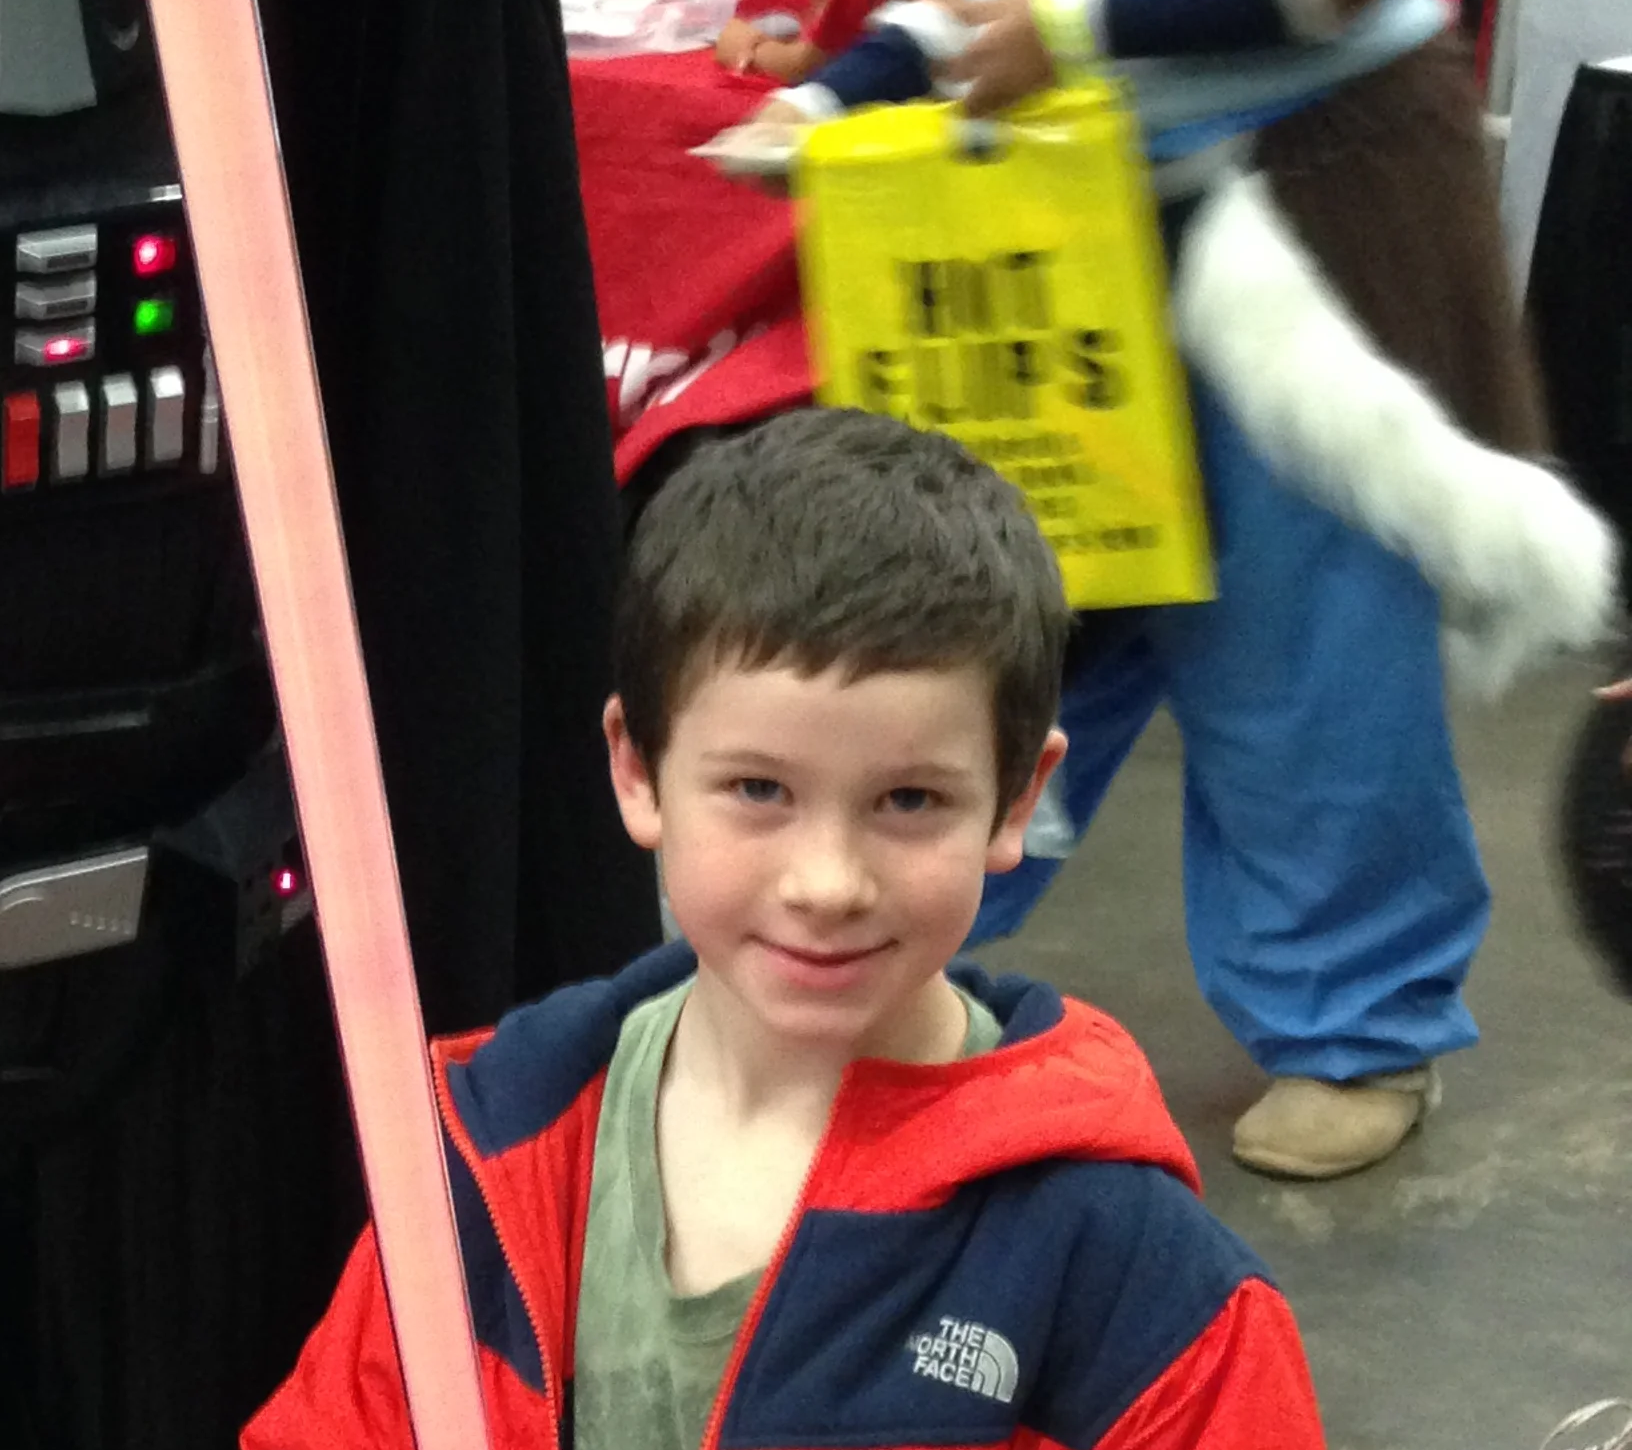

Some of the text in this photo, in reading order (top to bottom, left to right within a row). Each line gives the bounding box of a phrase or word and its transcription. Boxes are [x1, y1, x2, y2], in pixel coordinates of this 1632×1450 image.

[939, 1317, 986, 1348] THE
[906, 1333, 979, 1370] NORTH
[913, 1355, 973, 1388] FACE
